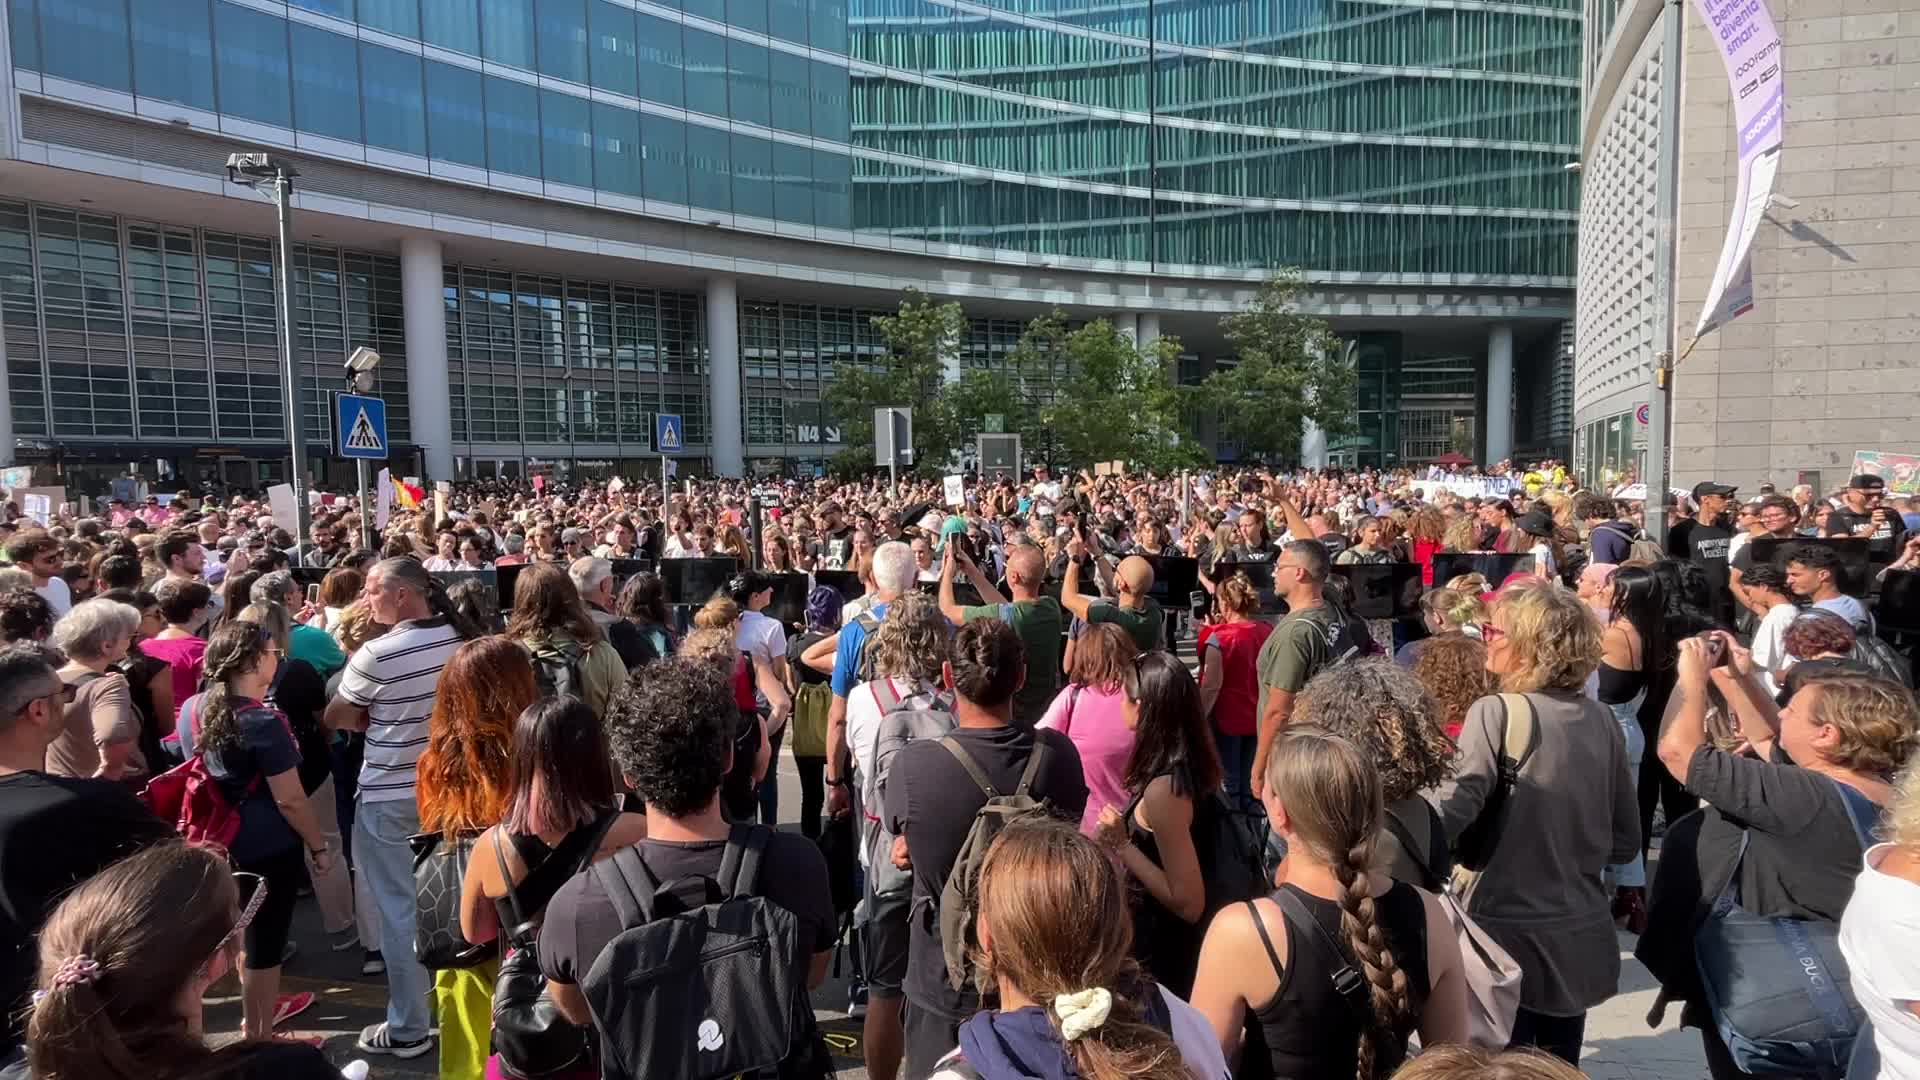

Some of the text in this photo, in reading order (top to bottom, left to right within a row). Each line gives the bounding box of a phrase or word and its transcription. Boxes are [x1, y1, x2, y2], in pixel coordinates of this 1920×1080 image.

[1711, 0, 1744, 27] bene
[1720, 0, 1760, 40] diventa
[799, 425, 820, 442] N4
